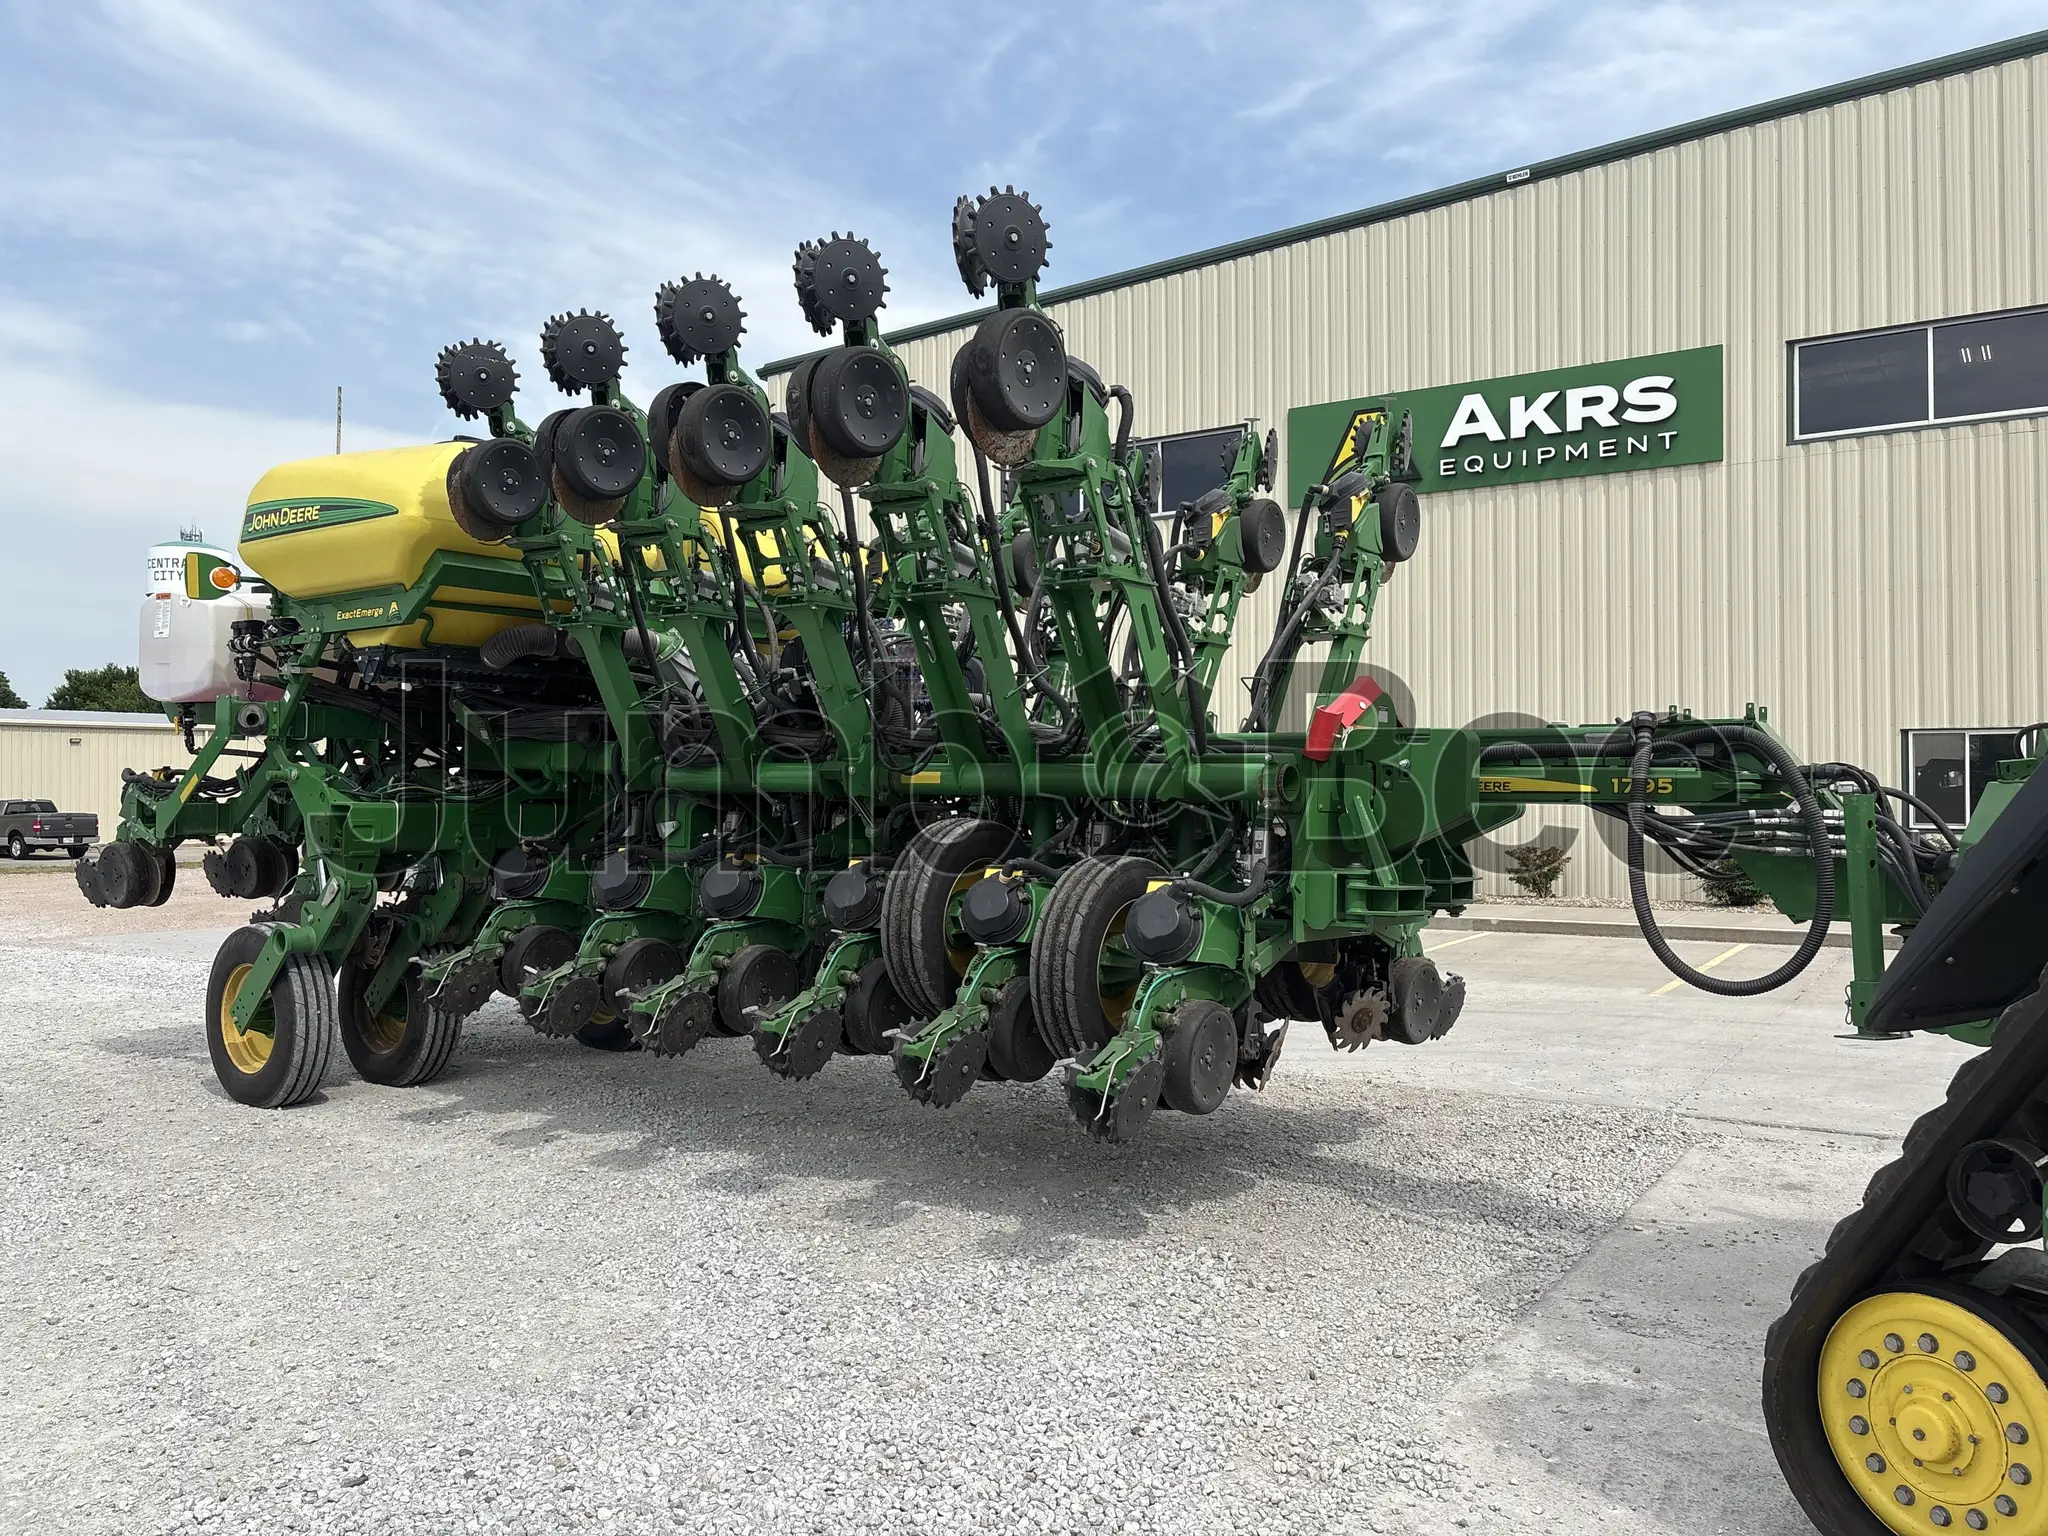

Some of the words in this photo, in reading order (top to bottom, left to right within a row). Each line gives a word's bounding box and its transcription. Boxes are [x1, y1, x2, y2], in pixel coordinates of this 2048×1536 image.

[1440, 375, 1678, 448] AKRS
[1439, 431, 1678, 475] EQUIPMENT
[247, 512, 280, 533] JOHN
[279, 506, 321, 525] DEERE
[148, 558, 187, 569] CENTRA
[154, 570, 183, 581] CITY
[336, 607, 384, 621] ExactEmerge
